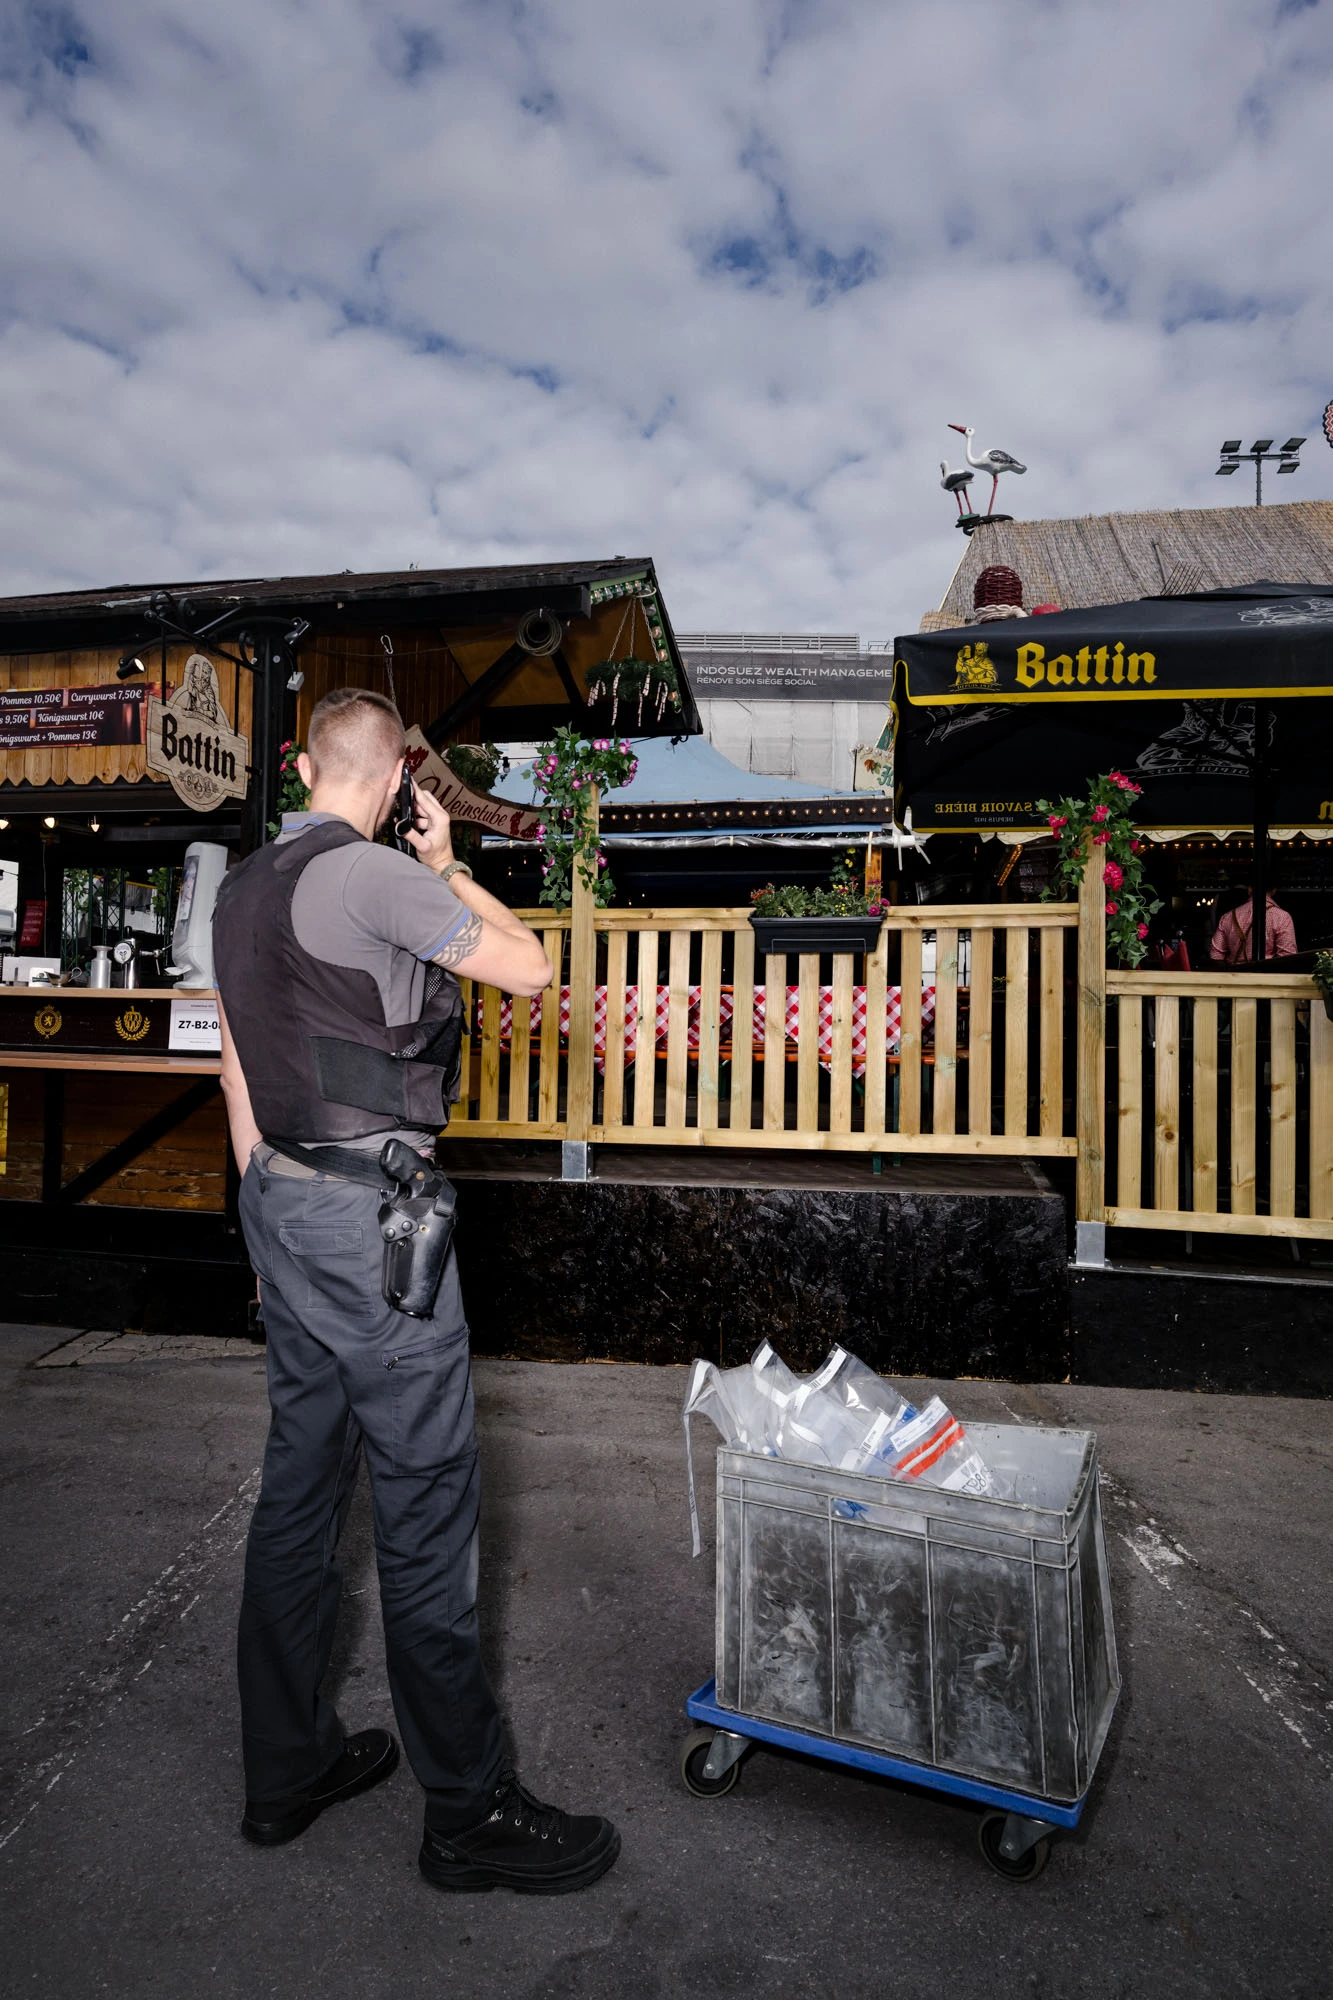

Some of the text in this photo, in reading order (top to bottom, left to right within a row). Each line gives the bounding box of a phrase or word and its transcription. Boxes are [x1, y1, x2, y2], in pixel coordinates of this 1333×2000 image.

[1015, 640, 1158, 689] Battin
[696, 666, 893, 678] INDOSUEZ WEALTH MANAGEME
[696, 676, 734, 685] RÉNOVE
[756, 676, 783, 686] SIÈGE
[784, 678, 817, 686] SOCIAL
[0, 693, 62, 705] Pommes 10,50€
[71, 689, 143, 706] Currywurst 7,50€
[5, 714, 29, 725] 9,50€
[38, 710, 105, 726] Königswurst 10€
[0, 733, 41, 746] önigswurst
[47, 732, 81, 742] Pommes
[82, 730, 98, 740] 13€
[160, 712, 237, 782] Battin
[178, 1020, 221, 1030] Z7-B2-0
